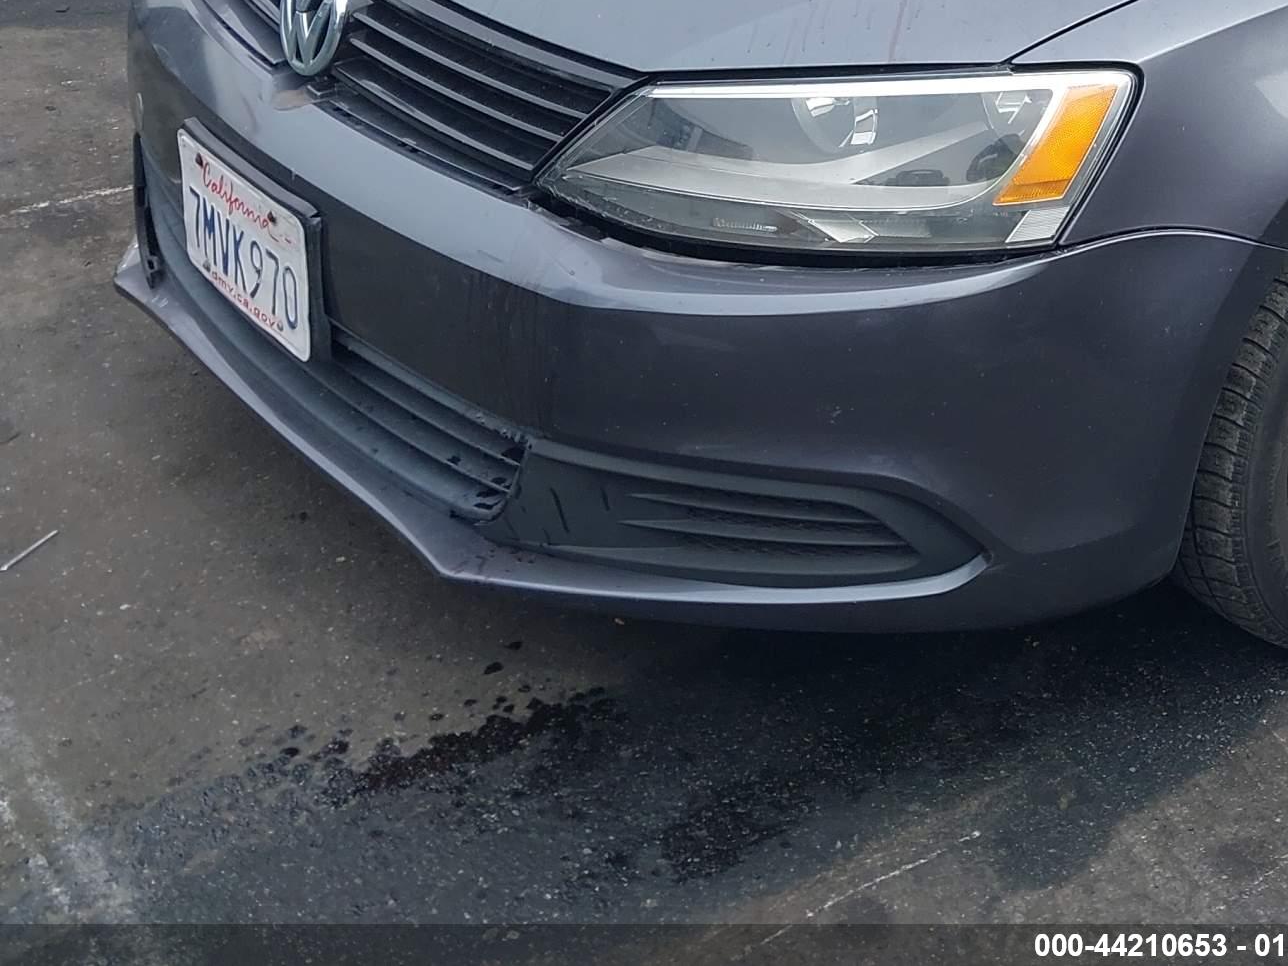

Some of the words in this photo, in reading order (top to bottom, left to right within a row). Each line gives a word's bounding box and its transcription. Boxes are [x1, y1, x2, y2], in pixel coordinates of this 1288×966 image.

[203, 161, 272, 236] California
[189, 186, 298, 330] 7MVK970
[211, 270, 275, 330] dmv.ca.gov
